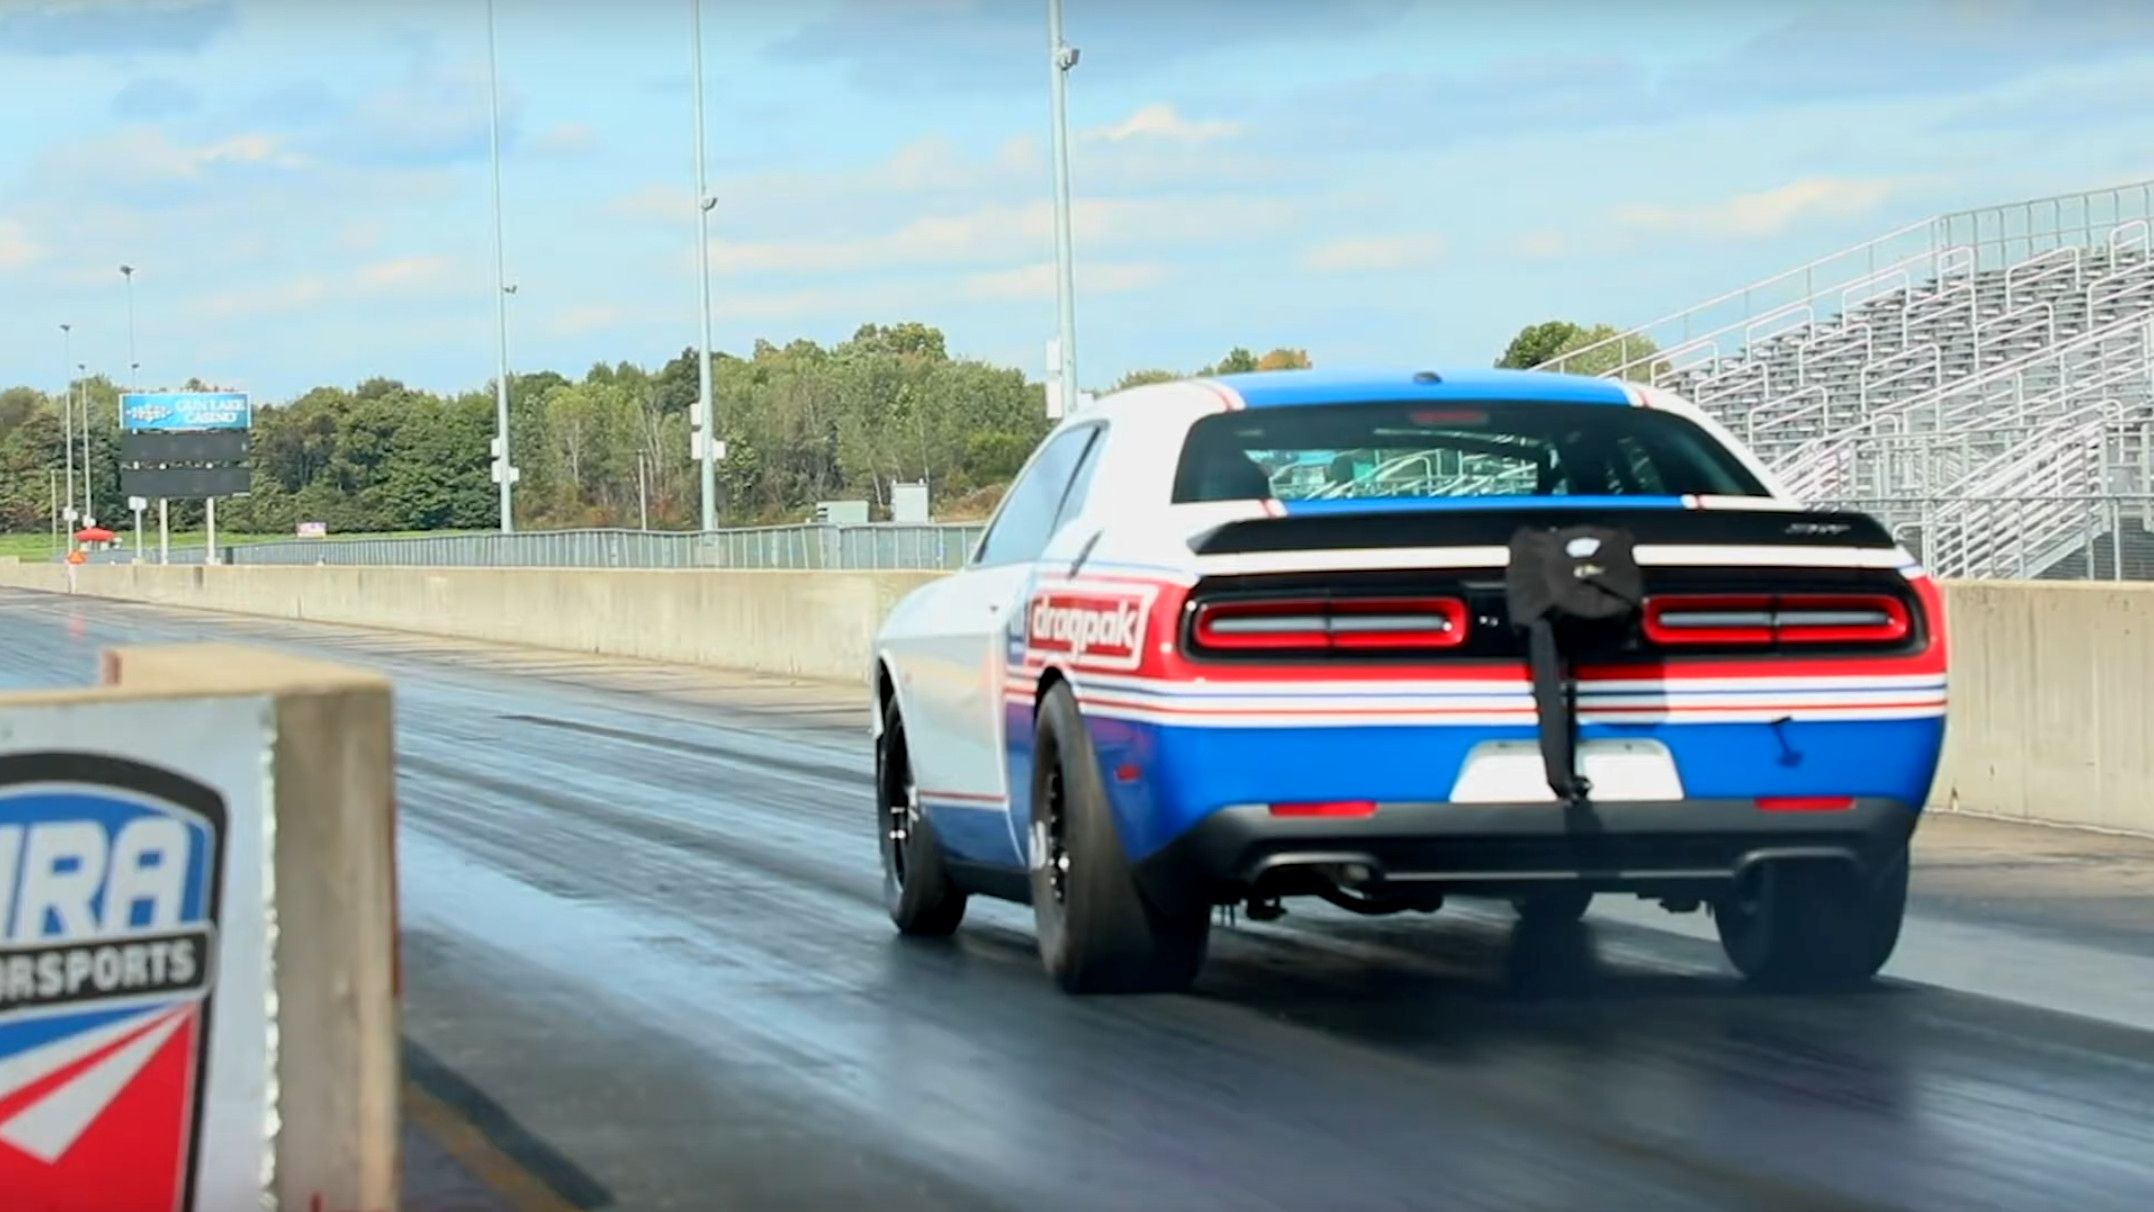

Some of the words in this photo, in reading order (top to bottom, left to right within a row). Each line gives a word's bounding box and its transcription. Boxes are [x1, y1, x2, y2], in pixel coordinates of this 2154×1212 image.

[1033, 596, 1139, 657] dragpak
[0, 818, 190, 938] RA
[0, 938, 196, 1000] RSPORTS
